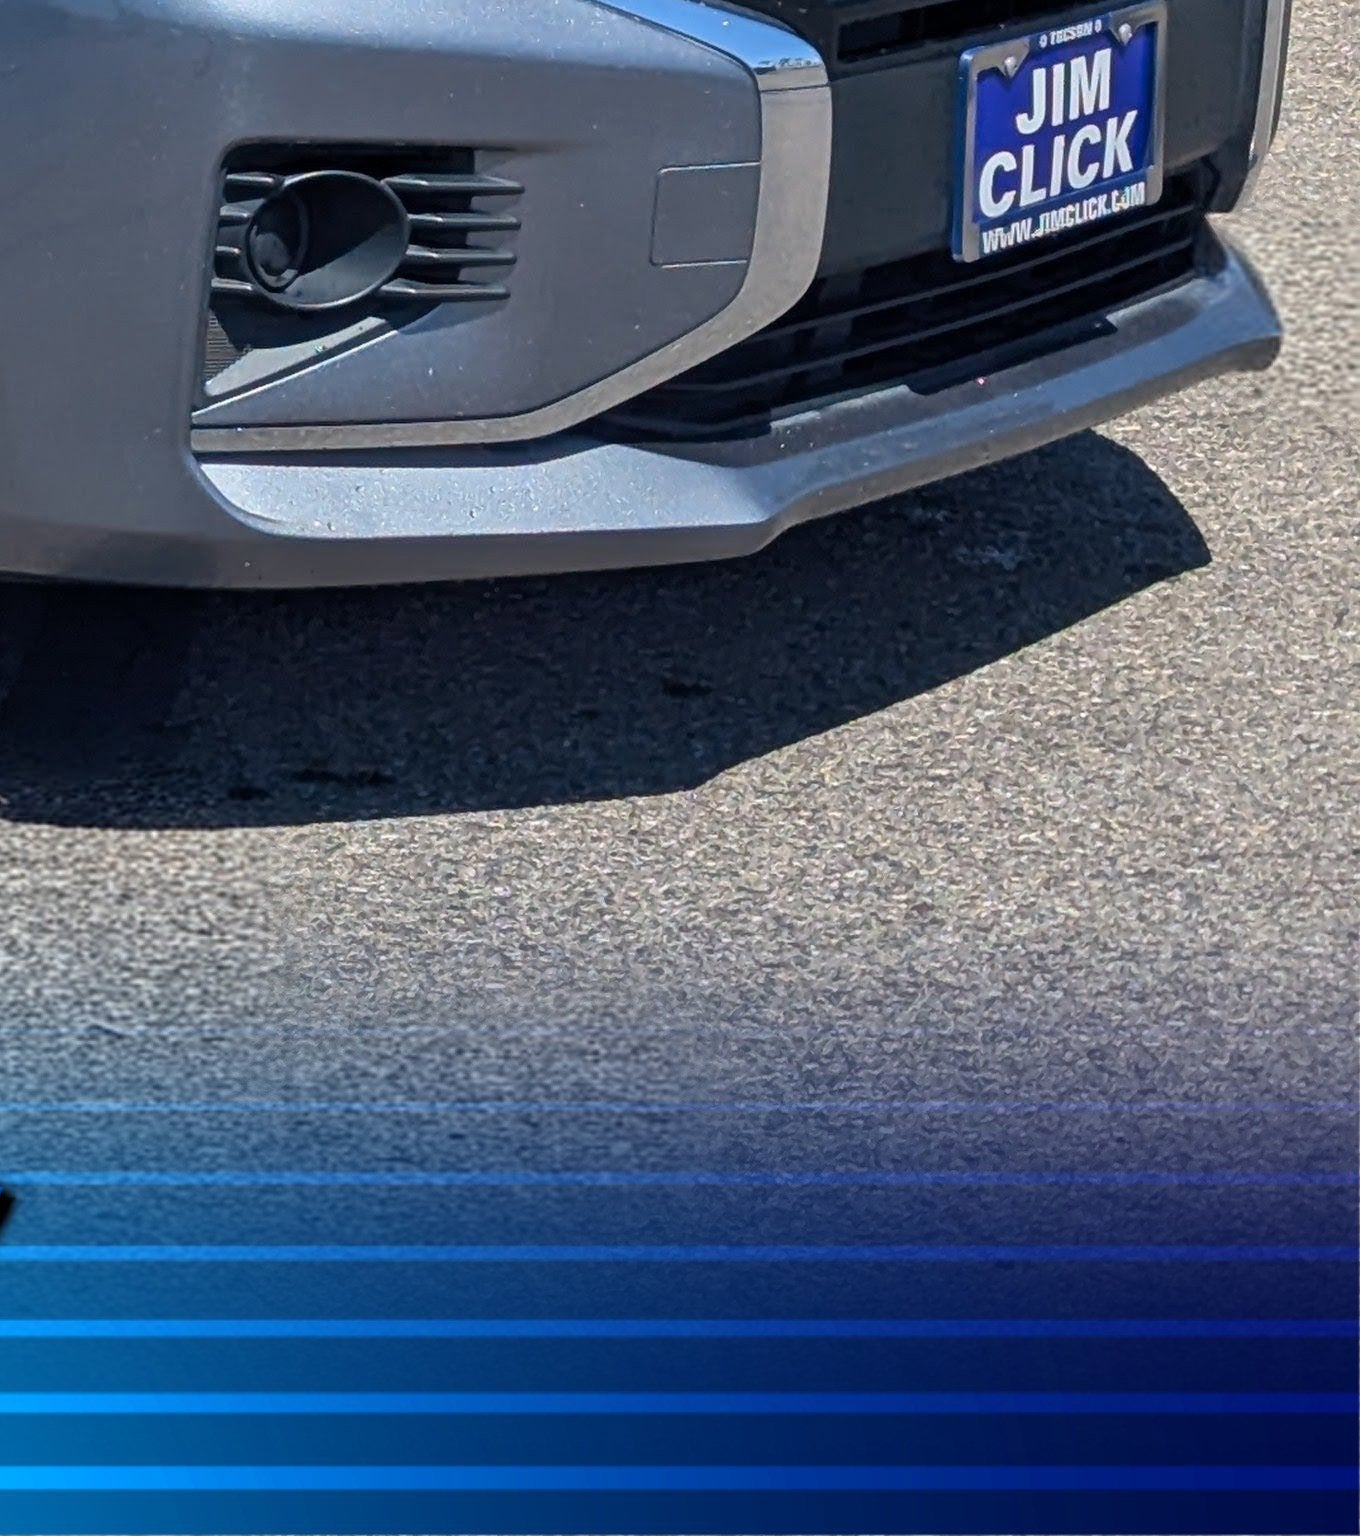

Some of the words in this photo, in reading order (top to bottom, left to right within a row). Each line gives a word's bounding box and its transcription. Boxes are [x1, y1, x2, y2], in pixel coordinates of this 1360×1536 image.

[1015, 47, 1112, 135] JIM
[978, 109, 1139, 219] CLICK
[981, 180, 1147, 255] WWW.JIMCLICK.COM
